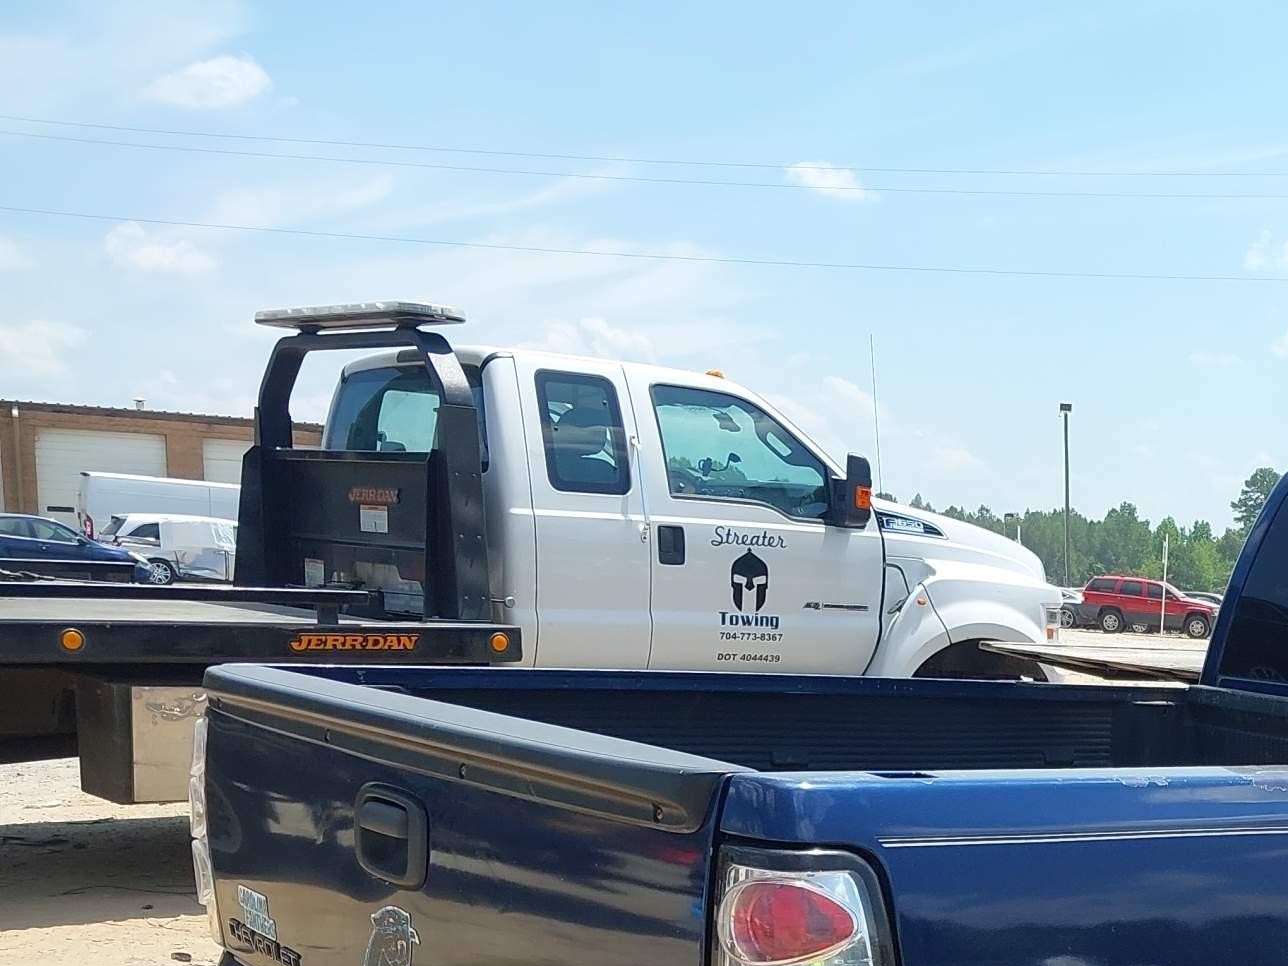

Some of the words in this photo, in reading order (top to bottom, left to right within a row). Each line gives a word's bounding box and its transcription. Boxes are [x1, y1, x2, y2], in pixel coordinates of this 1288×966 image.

[711, 526, 787, 548] Streater
[718, 612, 780, 629] Towing
[719, 632, 783, 642] 704-773-8367
[717, 653, 738, 662] DOT
